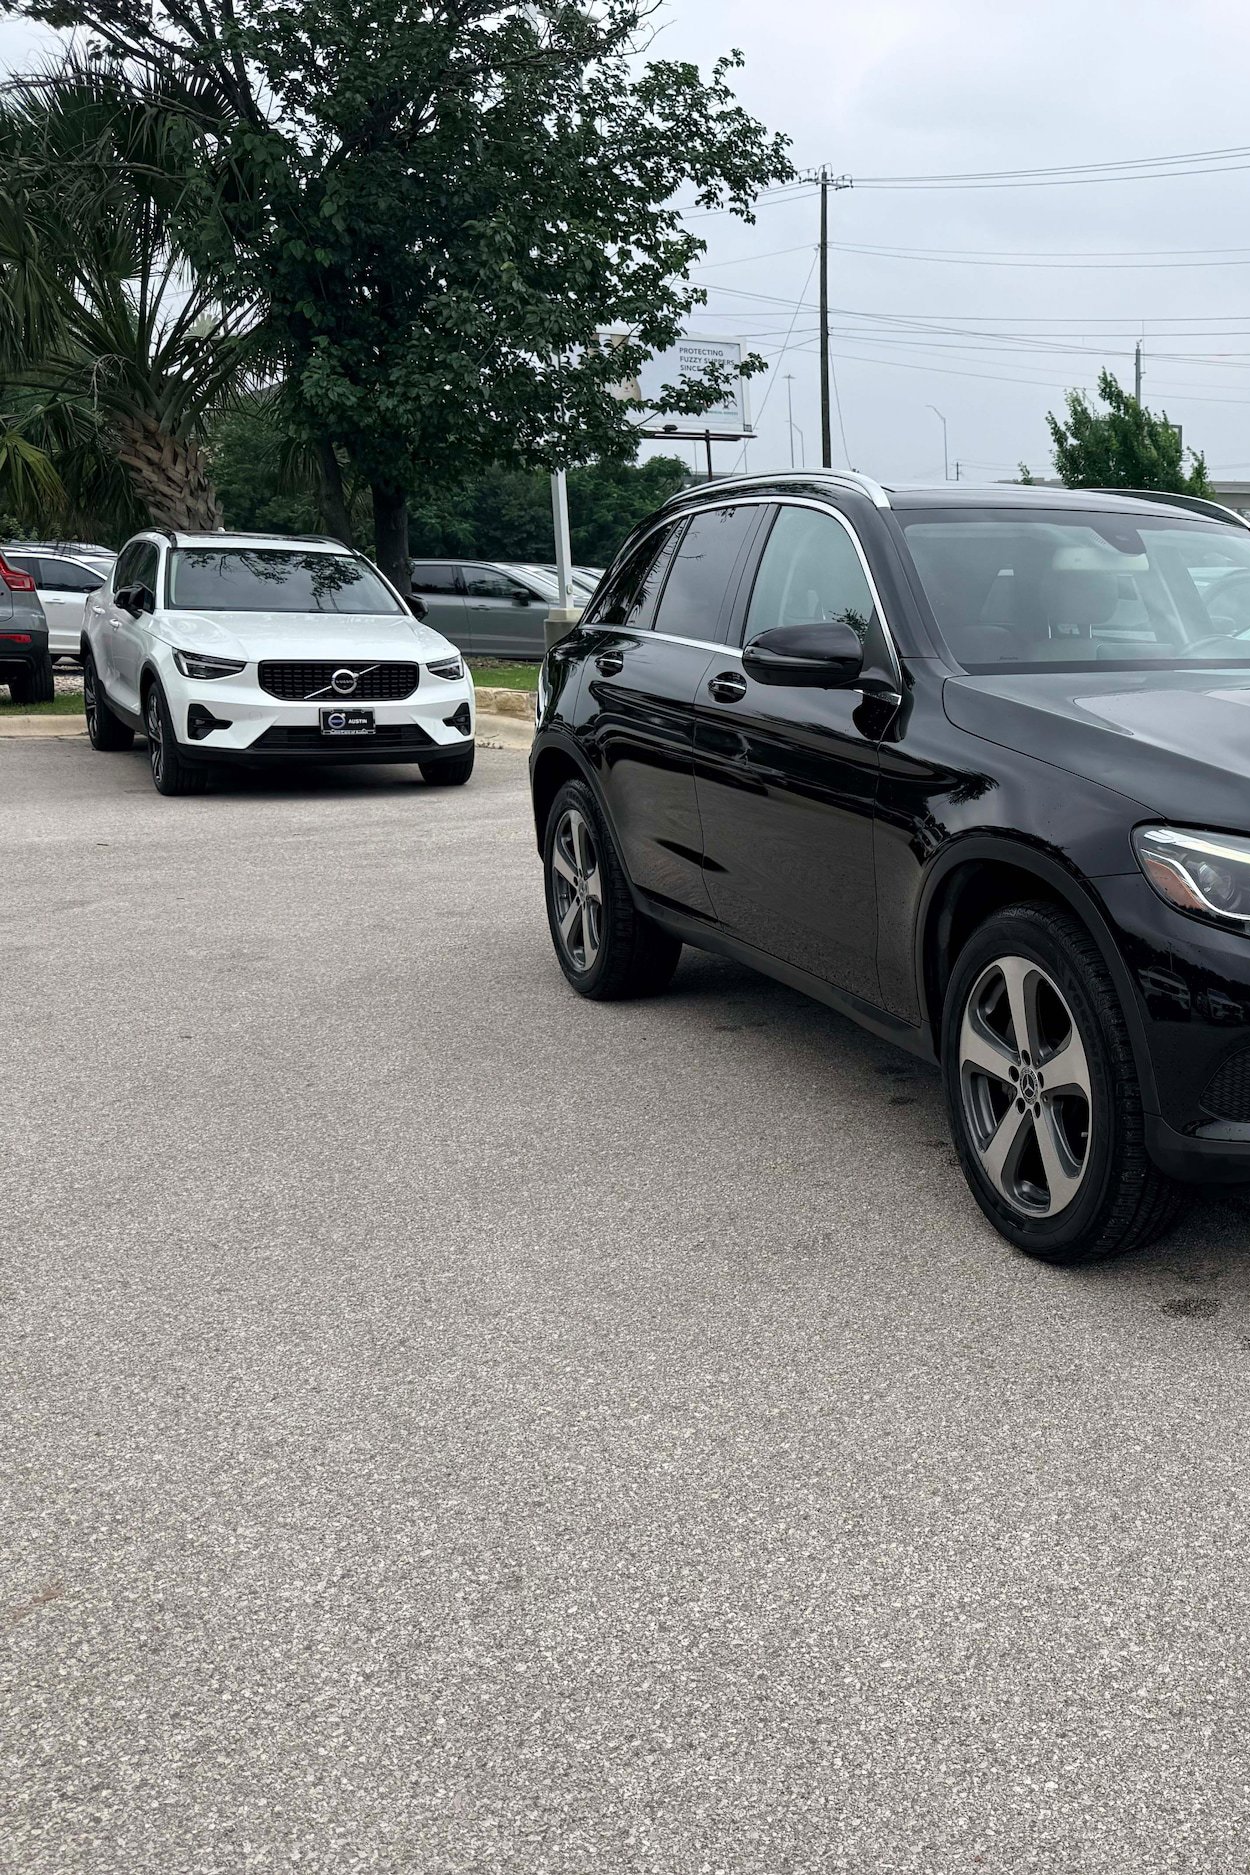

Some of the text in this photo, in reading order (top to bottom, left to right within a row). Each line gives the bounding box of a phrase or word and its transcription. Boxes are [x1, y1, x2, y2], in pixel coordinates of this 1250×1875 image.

[679, 347, 724, 357] PROTECTING
[680, 356, 702, 364] FUZZY
[680, 364, 701, 372] SINCE
